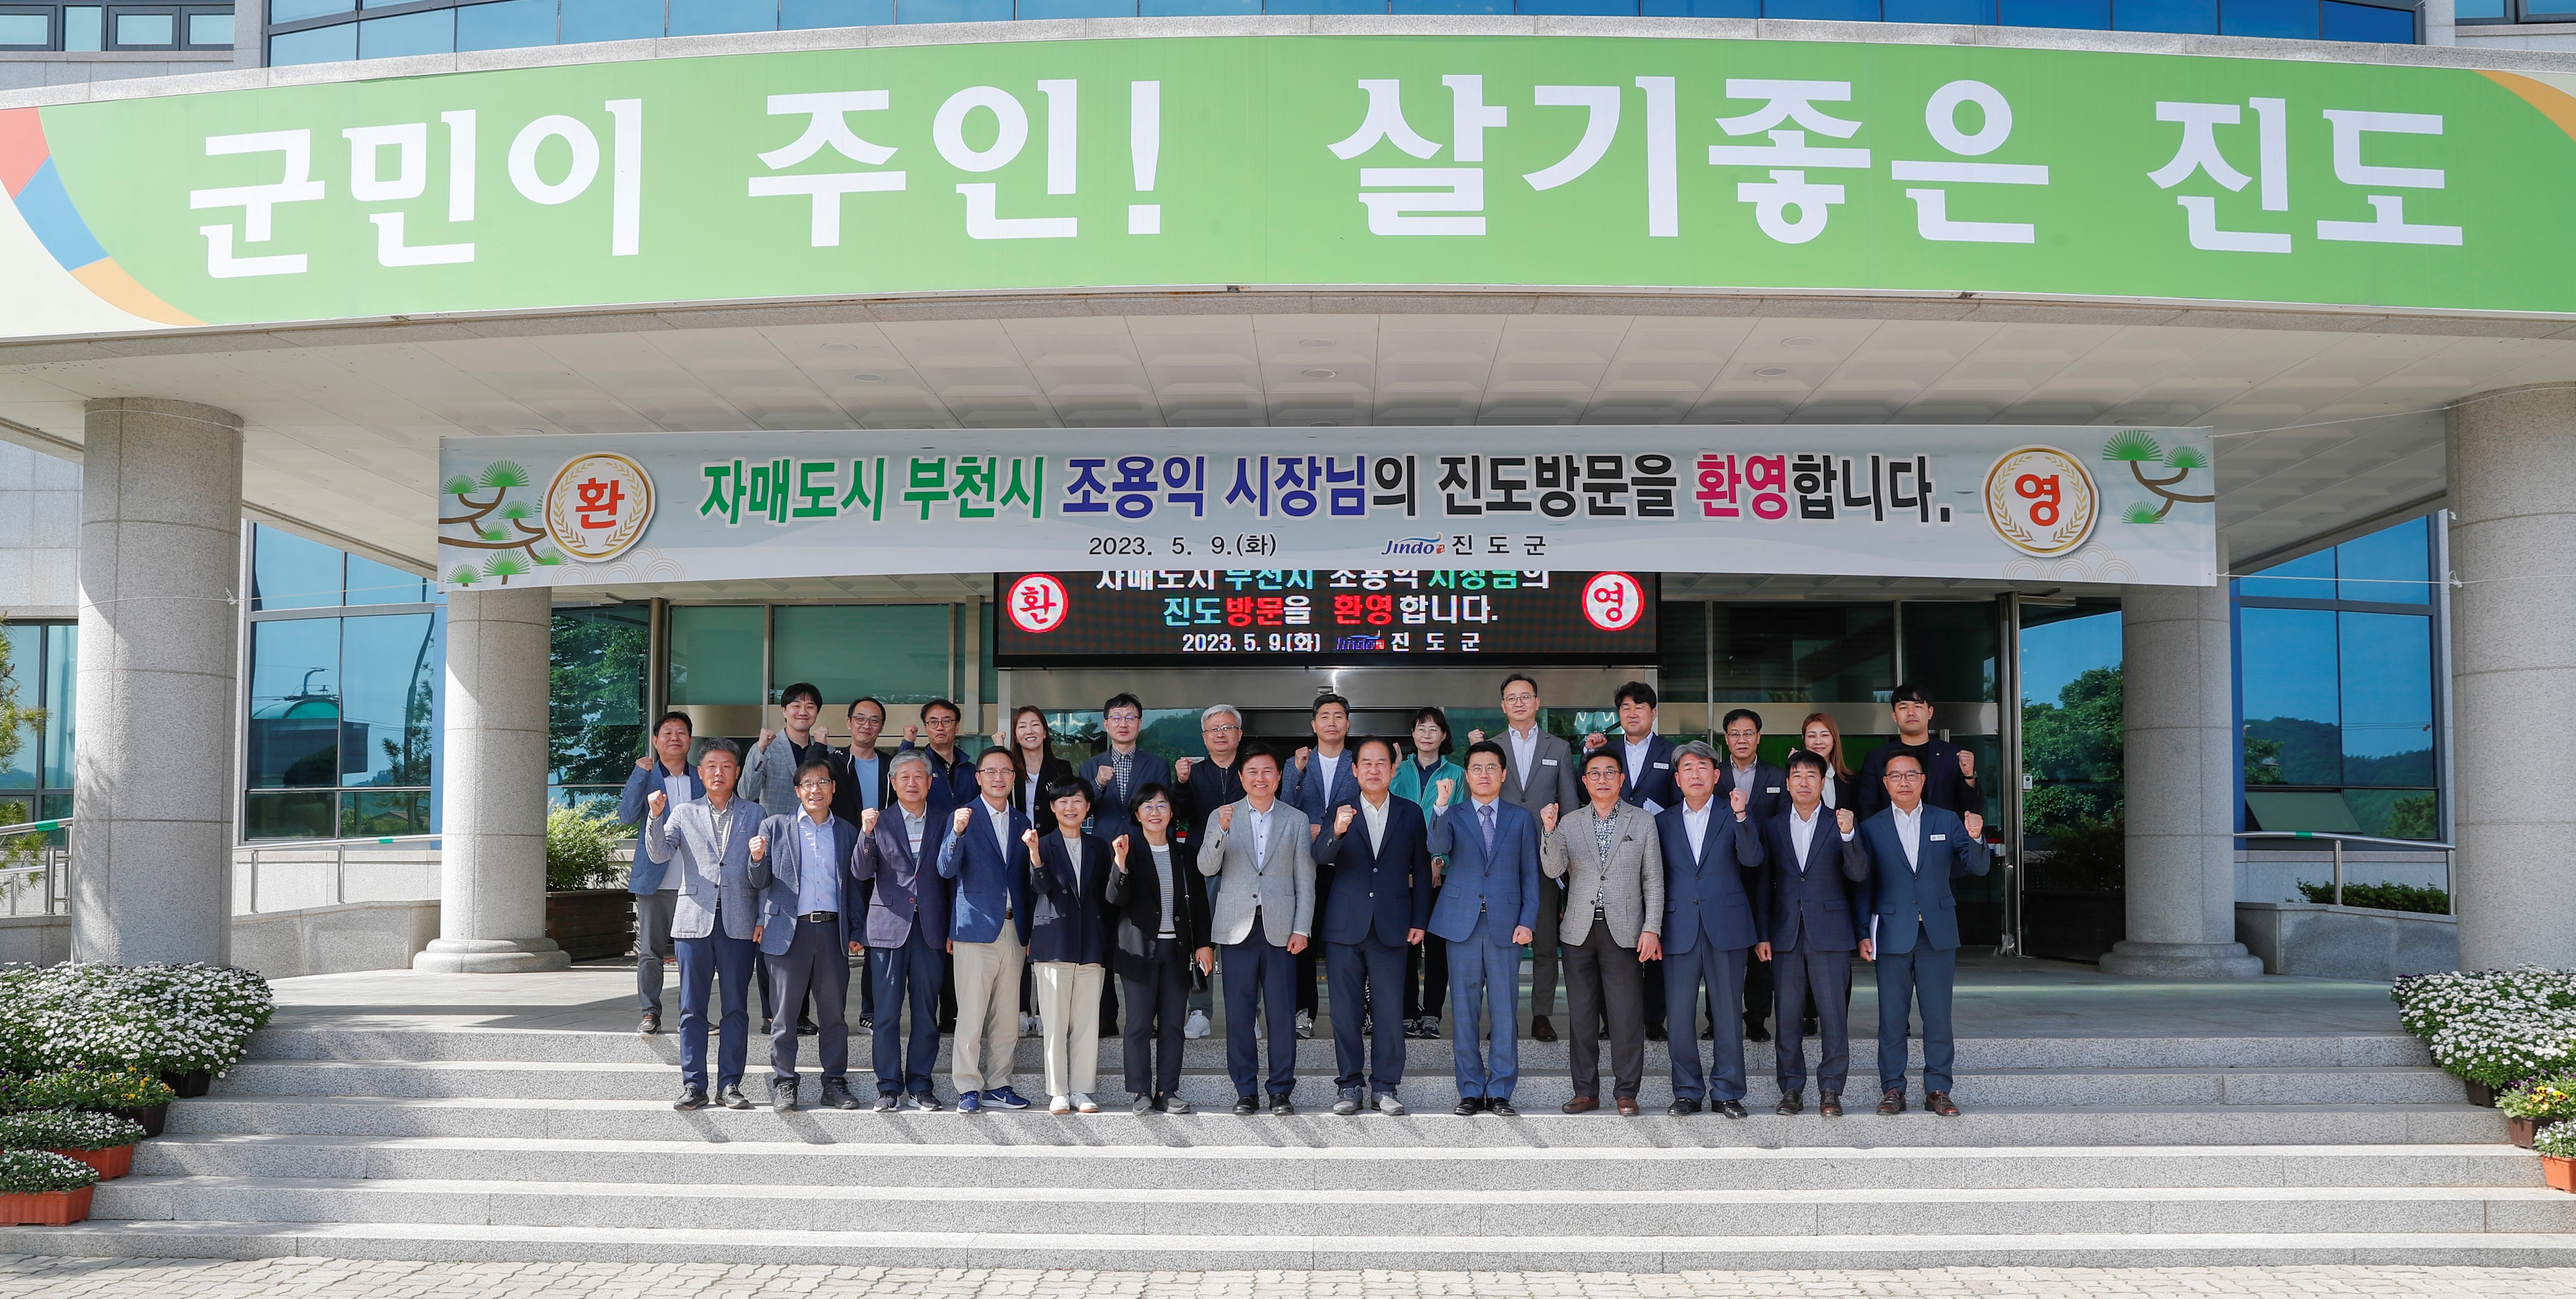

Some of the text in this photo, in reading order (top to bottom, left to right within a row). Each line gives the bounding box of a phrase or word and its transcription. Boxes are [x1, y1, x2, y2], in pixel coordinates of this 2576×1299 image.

[189, 74, 2463, 279] 군민이 주인! 살기좋은 진도
[576, 478, 625, 529] 환
[700, 454, 1950, 525] 자매도시 부천시 조용익 시장님의 진도방문을 환영합니다.
[2015, 474, 2061, 526] 영
[1089, 533, 1276, 557] 2023. 5. 9.(화)
[1381, 540, 1434, 555] Jindo
[1019, 584, 1057, 624] 환
[1162, 595, 1312, 627] 진도방문을
[1594, 582, 1623, 622] 영
[1182, 632, 1321, 652] 2023. 5. 9.(화)
